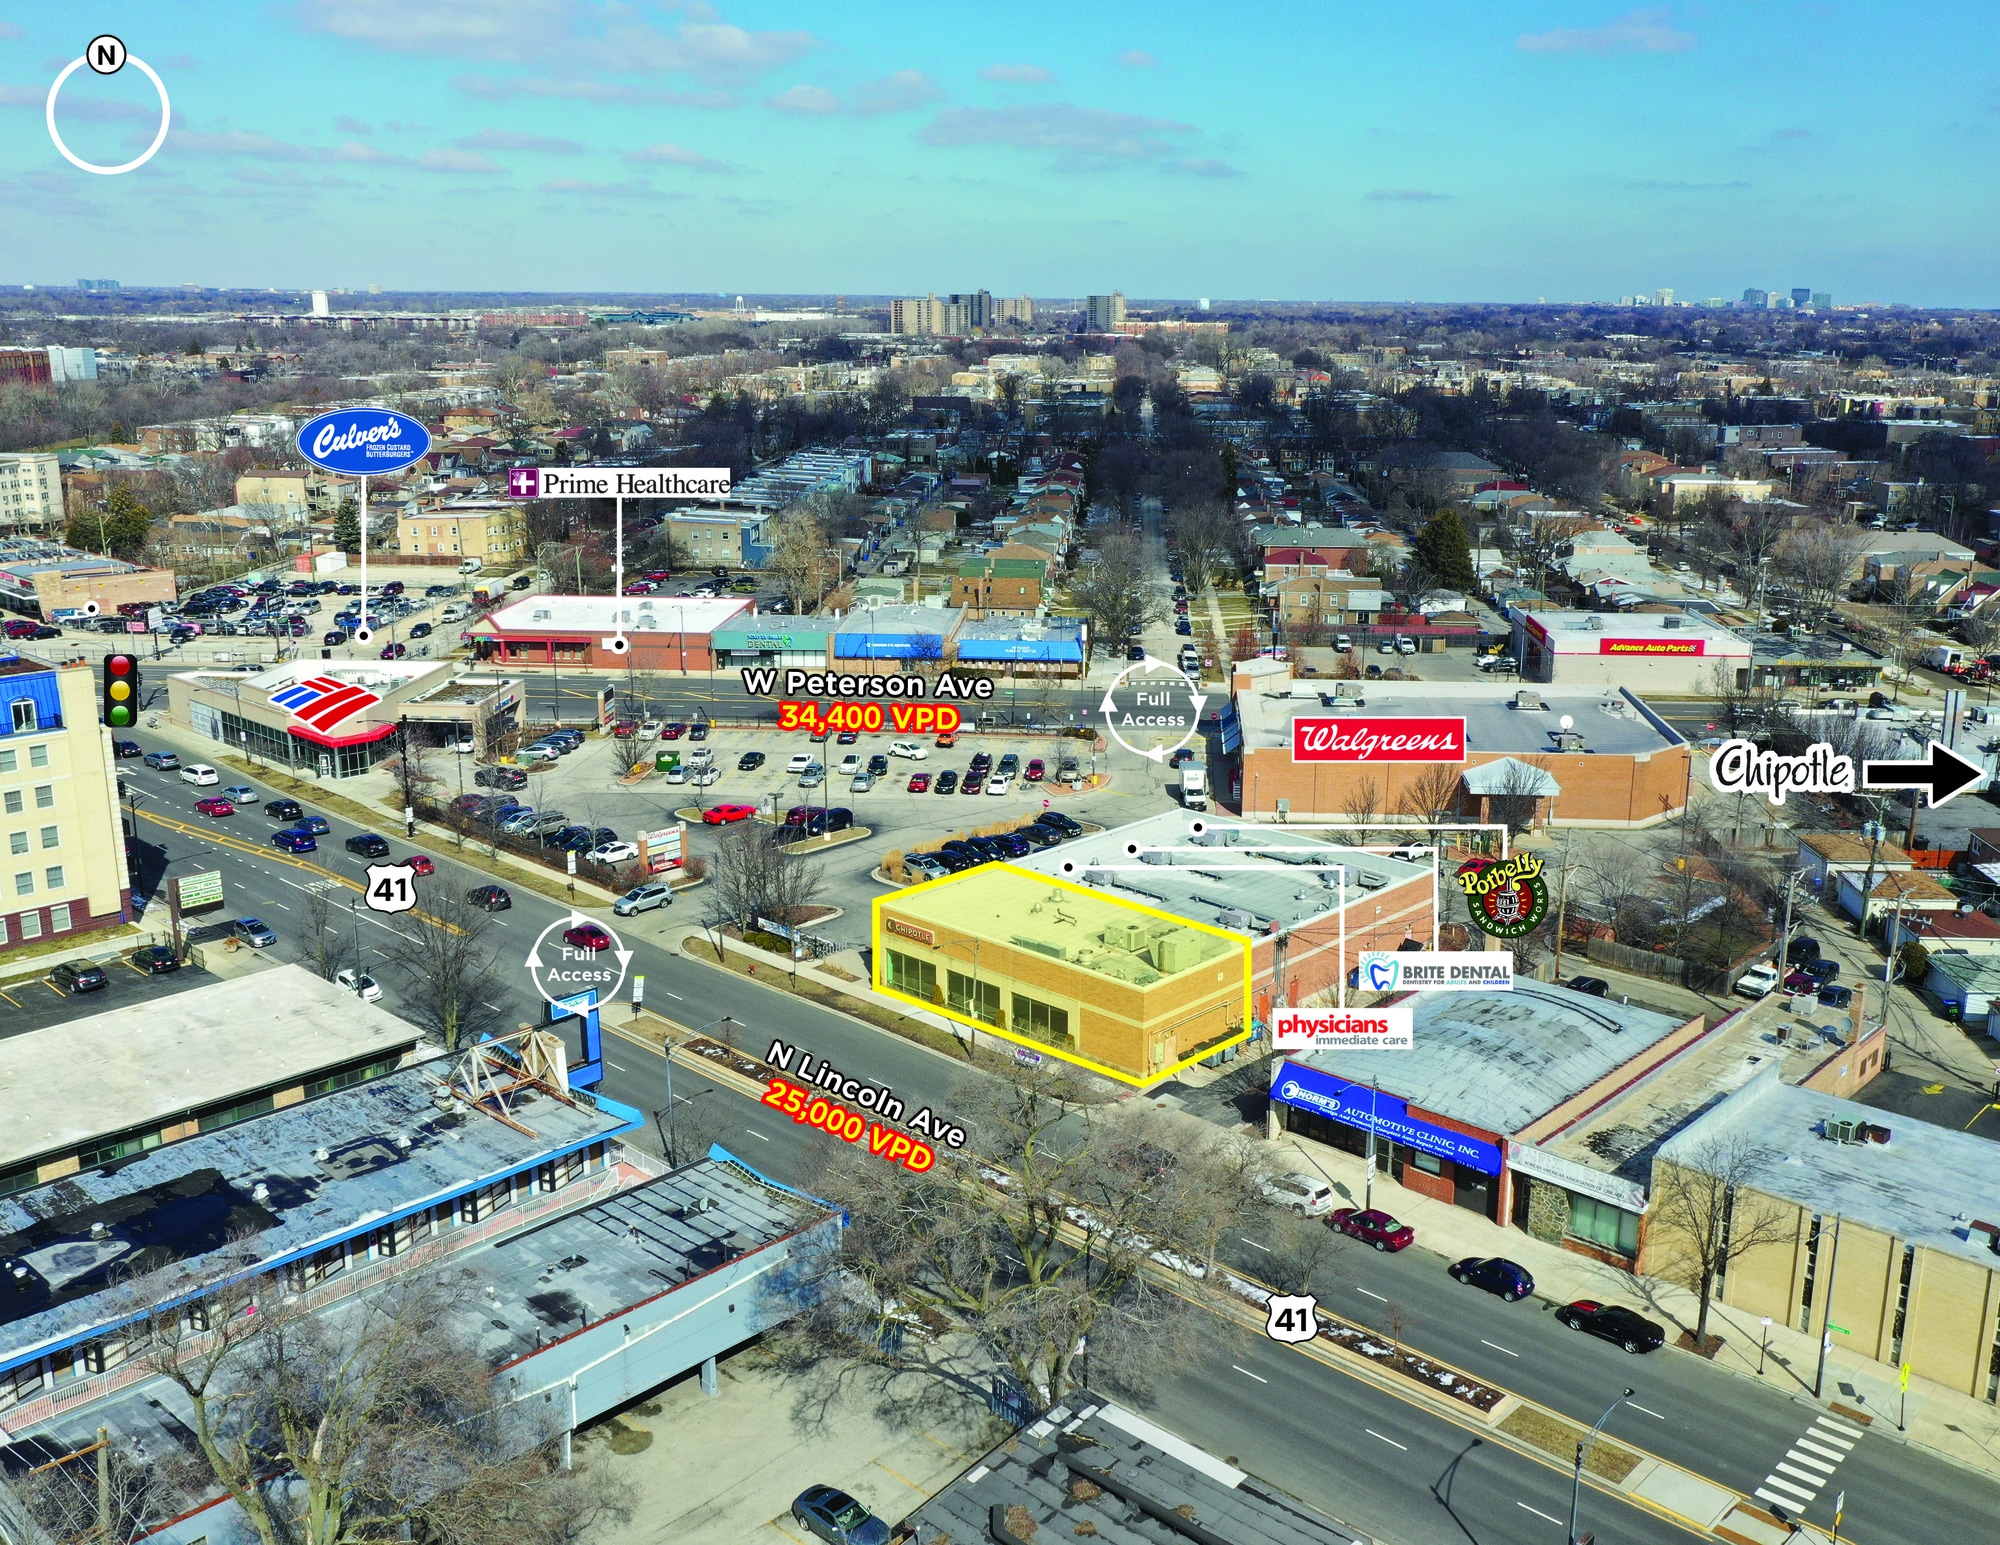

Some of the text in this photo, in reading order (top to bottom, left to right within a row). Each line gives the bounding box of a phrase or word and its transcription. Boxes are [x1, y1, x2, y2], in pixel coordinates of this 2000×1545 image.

[1609, 643, 1689, 653] Advance Auto Parts
[895, 924, 931, 942] CHIPOTLE
[1297, 1090, 1337, 1109] NORM'S
[1401, 1134, 1415, 1144] Auto
[1415, 1138, 1434, 1150] Repair
[1433, 1144, 1455, 1156] Service
[1415, 1130, 1456, 1151] CLINIC,
[1456, 1144, 1480, 1160] INC.
[1524, 1160, 1542, 1172] KOREAN
[1542, 1166, 1565, 1180] AMERICAN
[1565, 1174, 1596, 1190] ASSOCIATION
